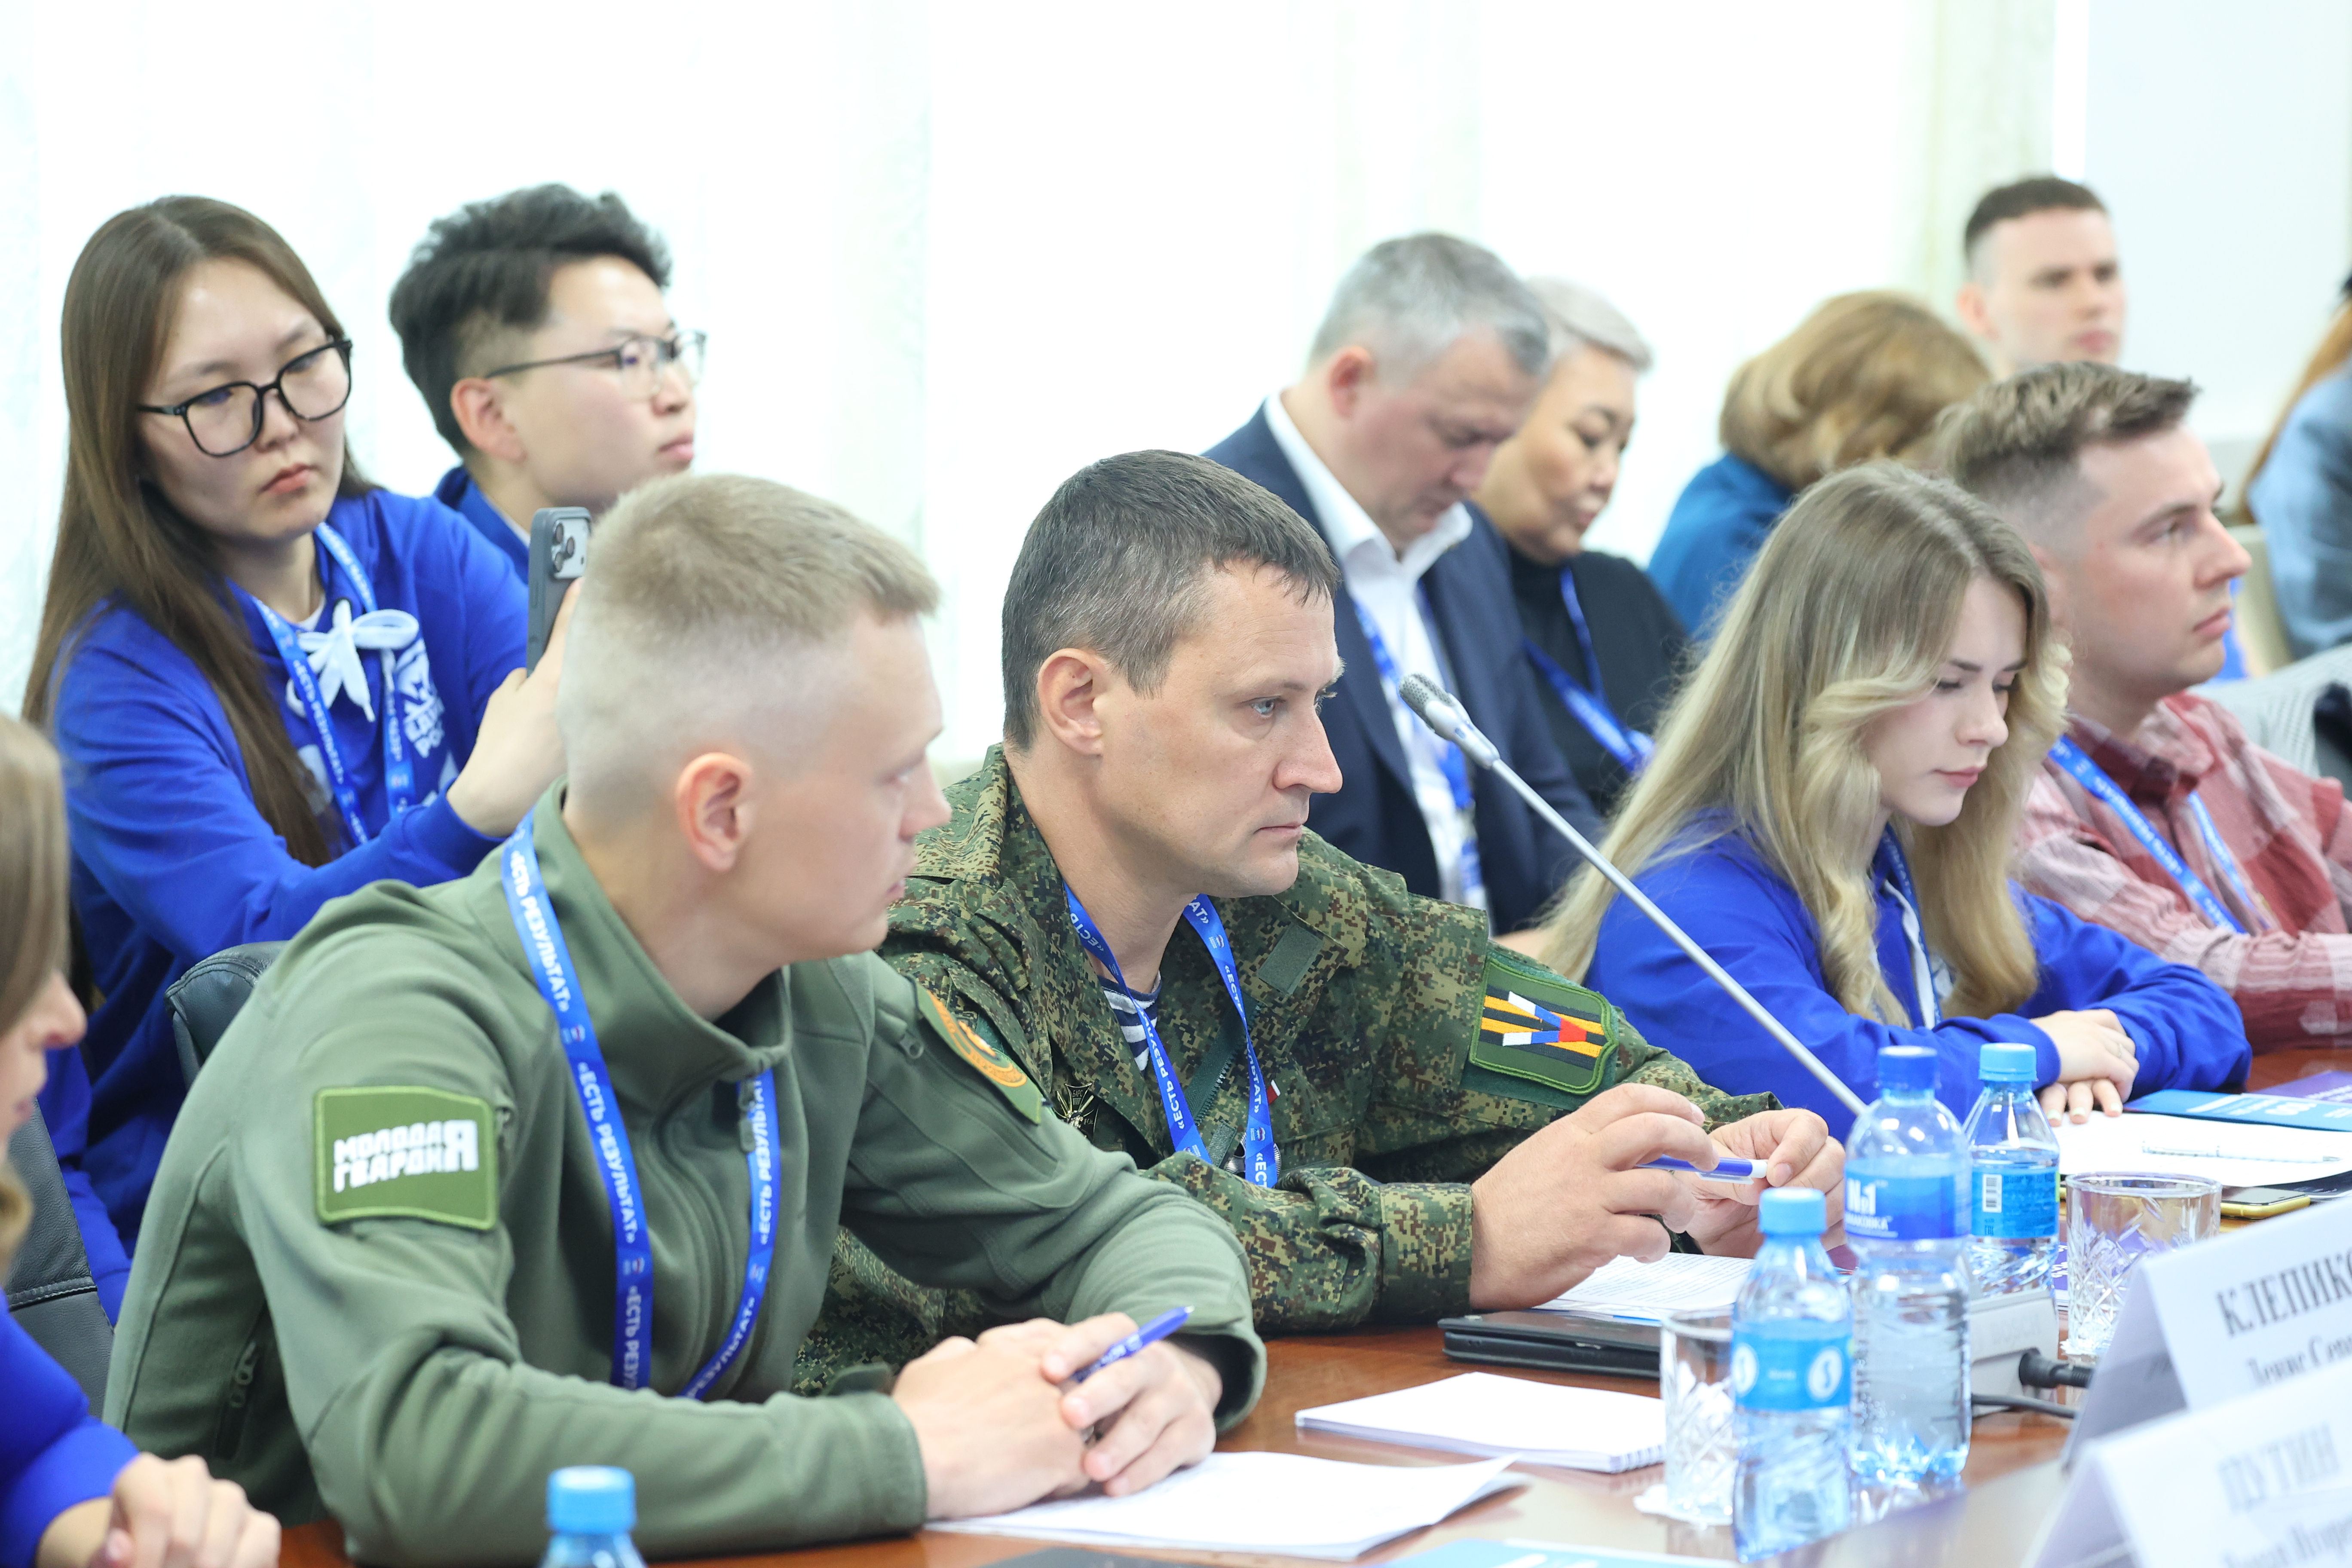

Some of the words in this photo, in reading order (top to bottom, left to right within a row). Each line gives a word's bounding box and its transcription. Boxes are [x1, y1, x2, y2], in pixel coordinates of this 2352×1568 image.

[1139, 1006, 1169, 1078] РЕЗУЛЬТ
[1166, 1080, 1185, 1130] «ЕСТЬ
[578, 1062, 606, 1122] «ЕСТЬ
[596, 1122, 638, 1243] РЕЗУЛЬТАТ»
[759, 1185, 772, 1245] «ЕСТЬ
